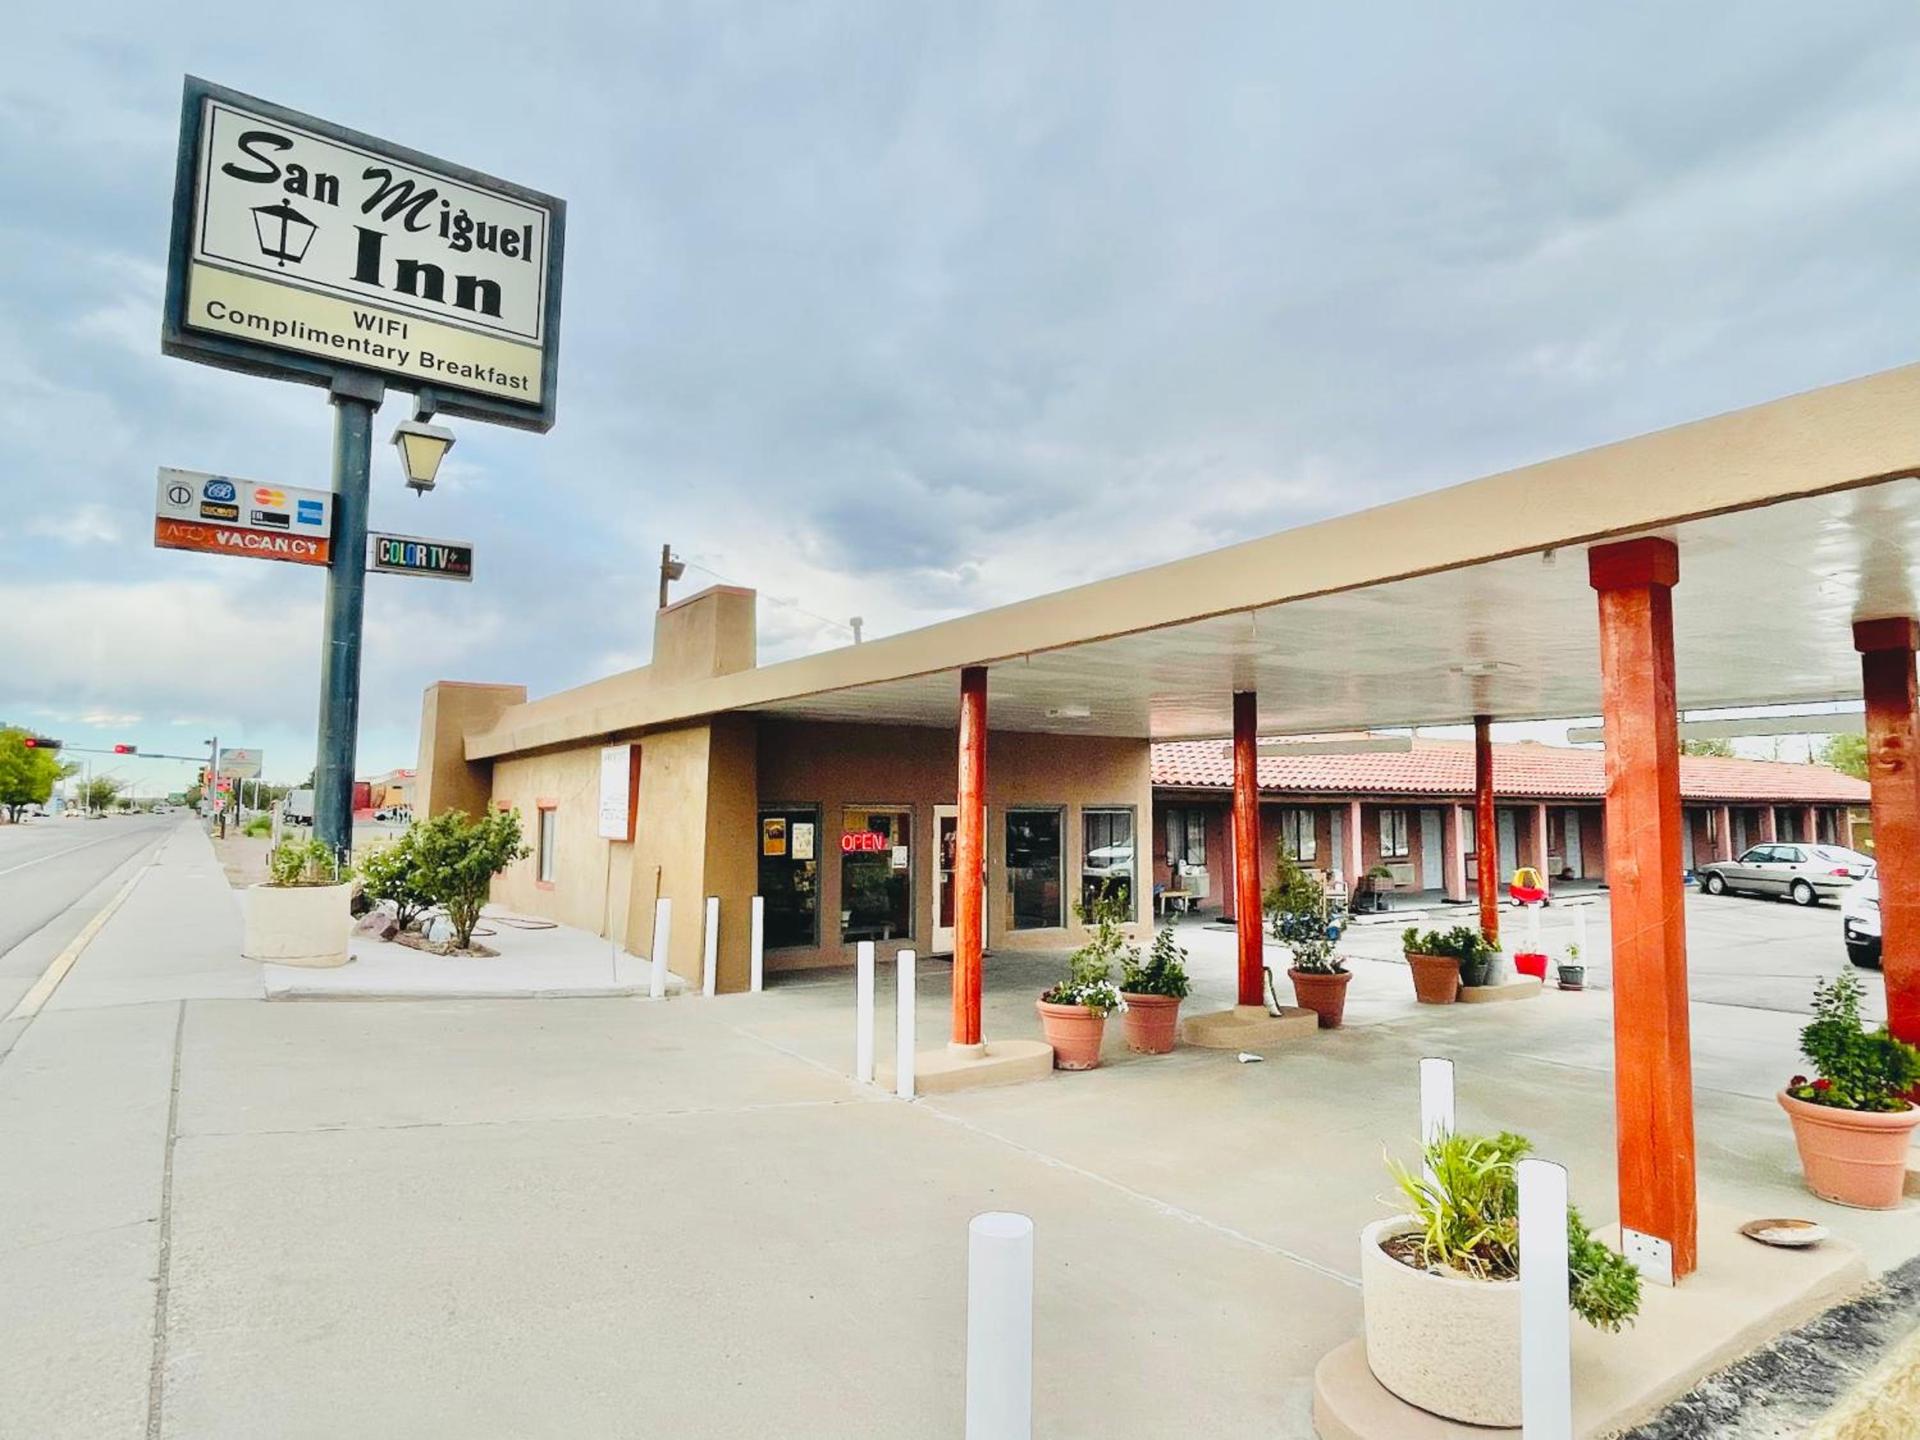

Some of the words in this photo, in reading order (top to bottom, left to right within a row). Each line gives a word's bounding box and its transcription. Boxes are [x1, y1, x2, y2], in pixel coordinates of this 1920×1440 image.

[221, 131, 340, 206] San
[361, 166, 533, 263] Miguel
[350, 225, 503, 319] Inn
[353, 311, 408, 339] WIFI
[206, 301, 410, 366] Complimentary
[419, 352, 529, 391] Breakfast
[215, 529, 317, 555] VACANCY
[380, 540, 427, 567] COLOR
[429, 546, 449, 568] TV
[841, 834, 883, 851] OPEN
